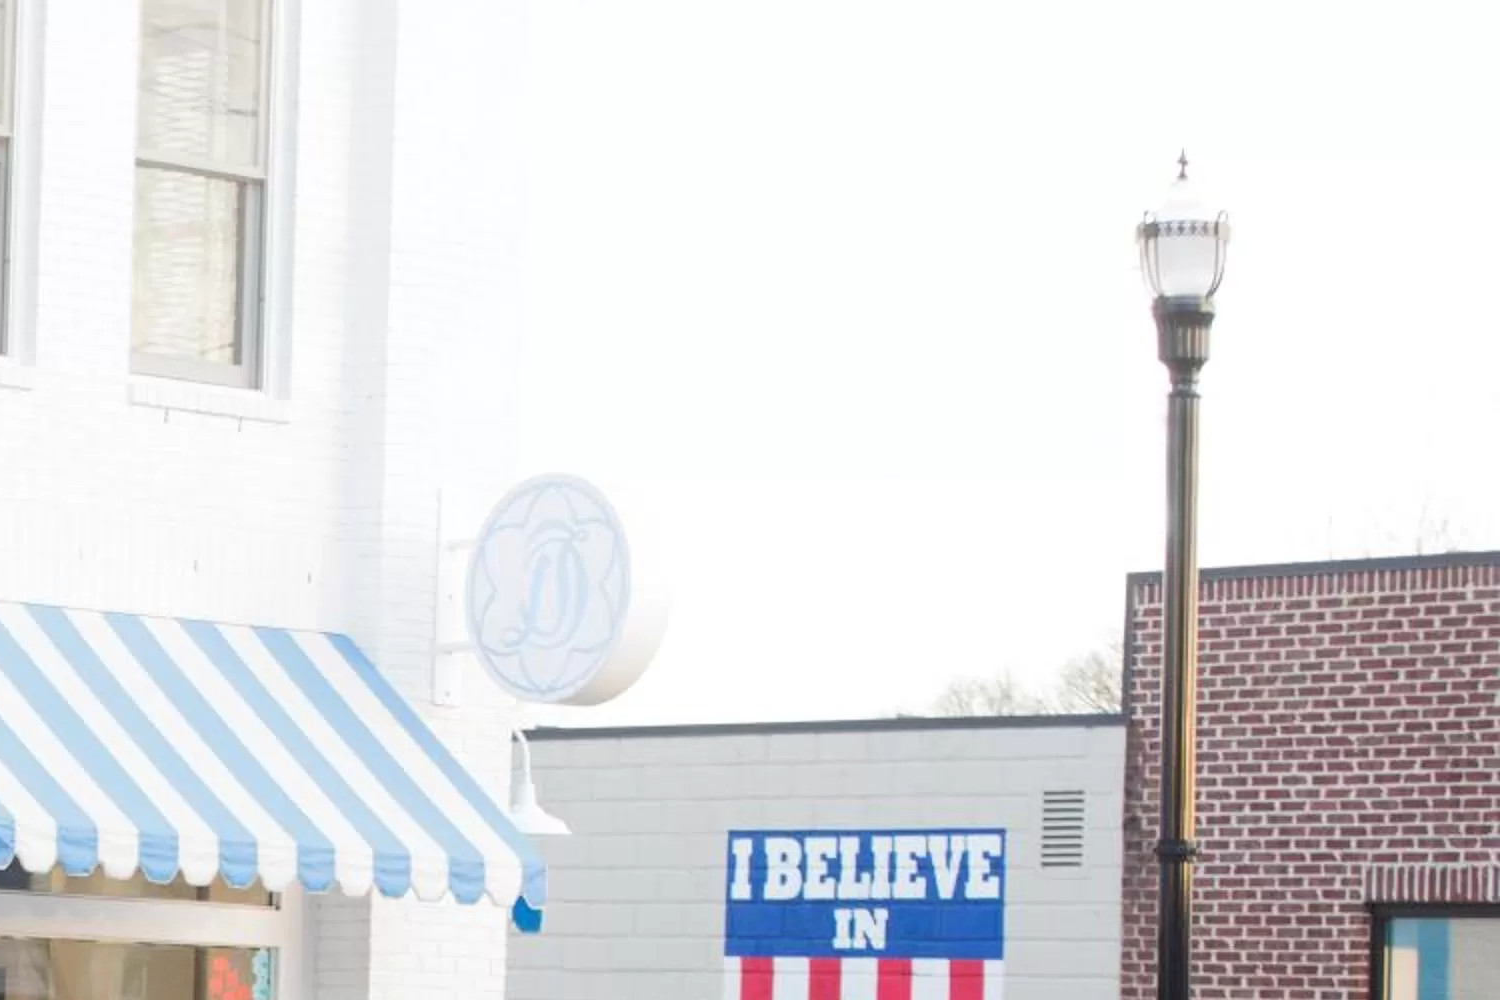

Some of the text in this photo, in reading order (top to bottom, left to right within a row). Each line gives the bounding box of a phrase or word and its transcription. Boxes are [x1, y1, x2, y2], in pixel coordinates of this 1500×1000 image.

[731, 834, 1001, 901] I BELIEVE
[832, 908, 888, 951] IN
